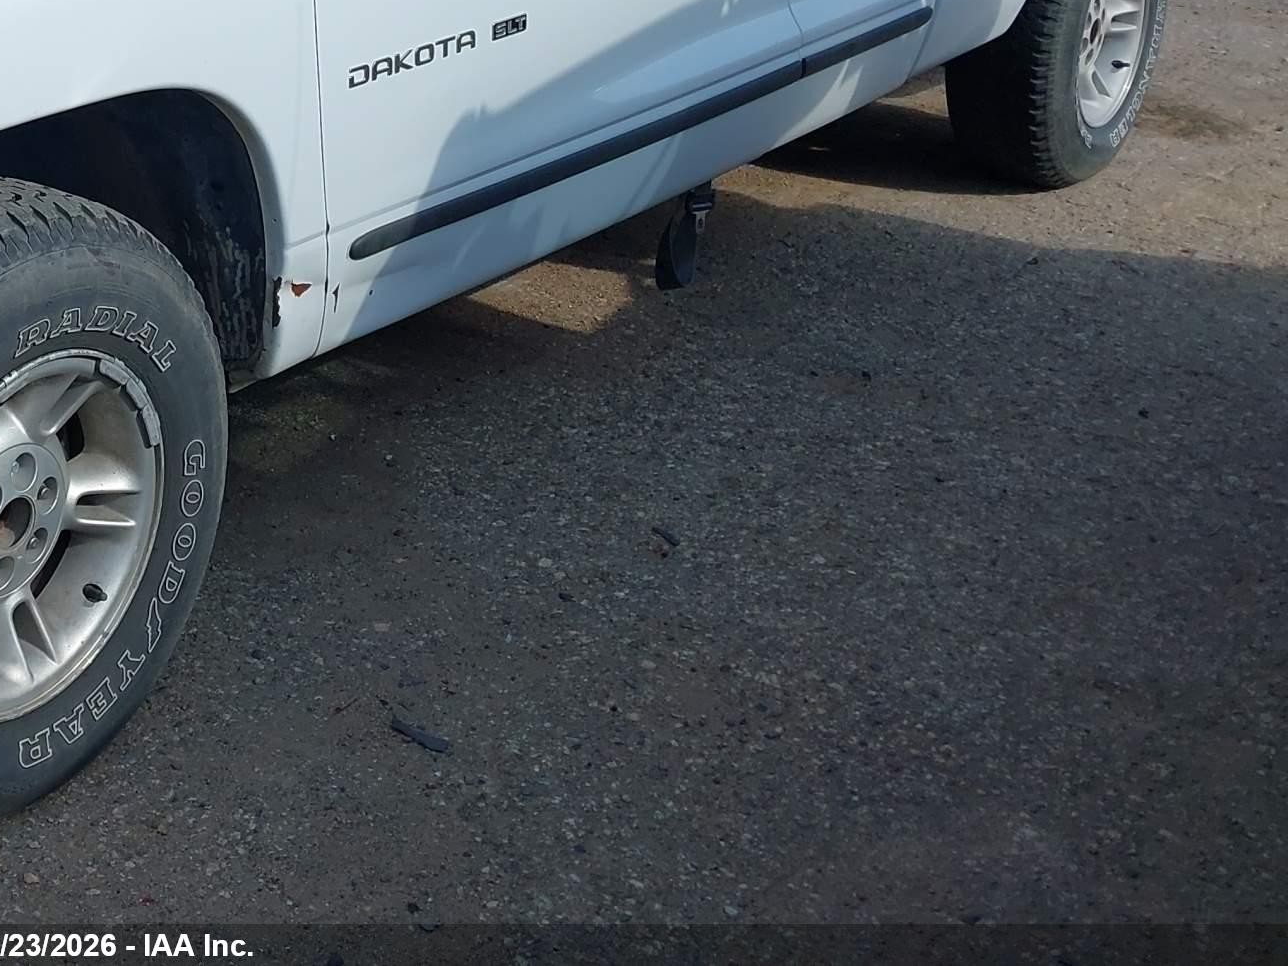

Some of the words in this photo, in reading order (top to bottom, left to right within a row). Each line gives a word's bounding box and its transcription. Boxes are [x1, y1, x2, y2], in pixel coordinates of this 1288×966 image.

[348, 29, 476, 89] DAKOTA
[492, 14, 527, 40] SLT
[14, 305, 178, 372] RADIAL
